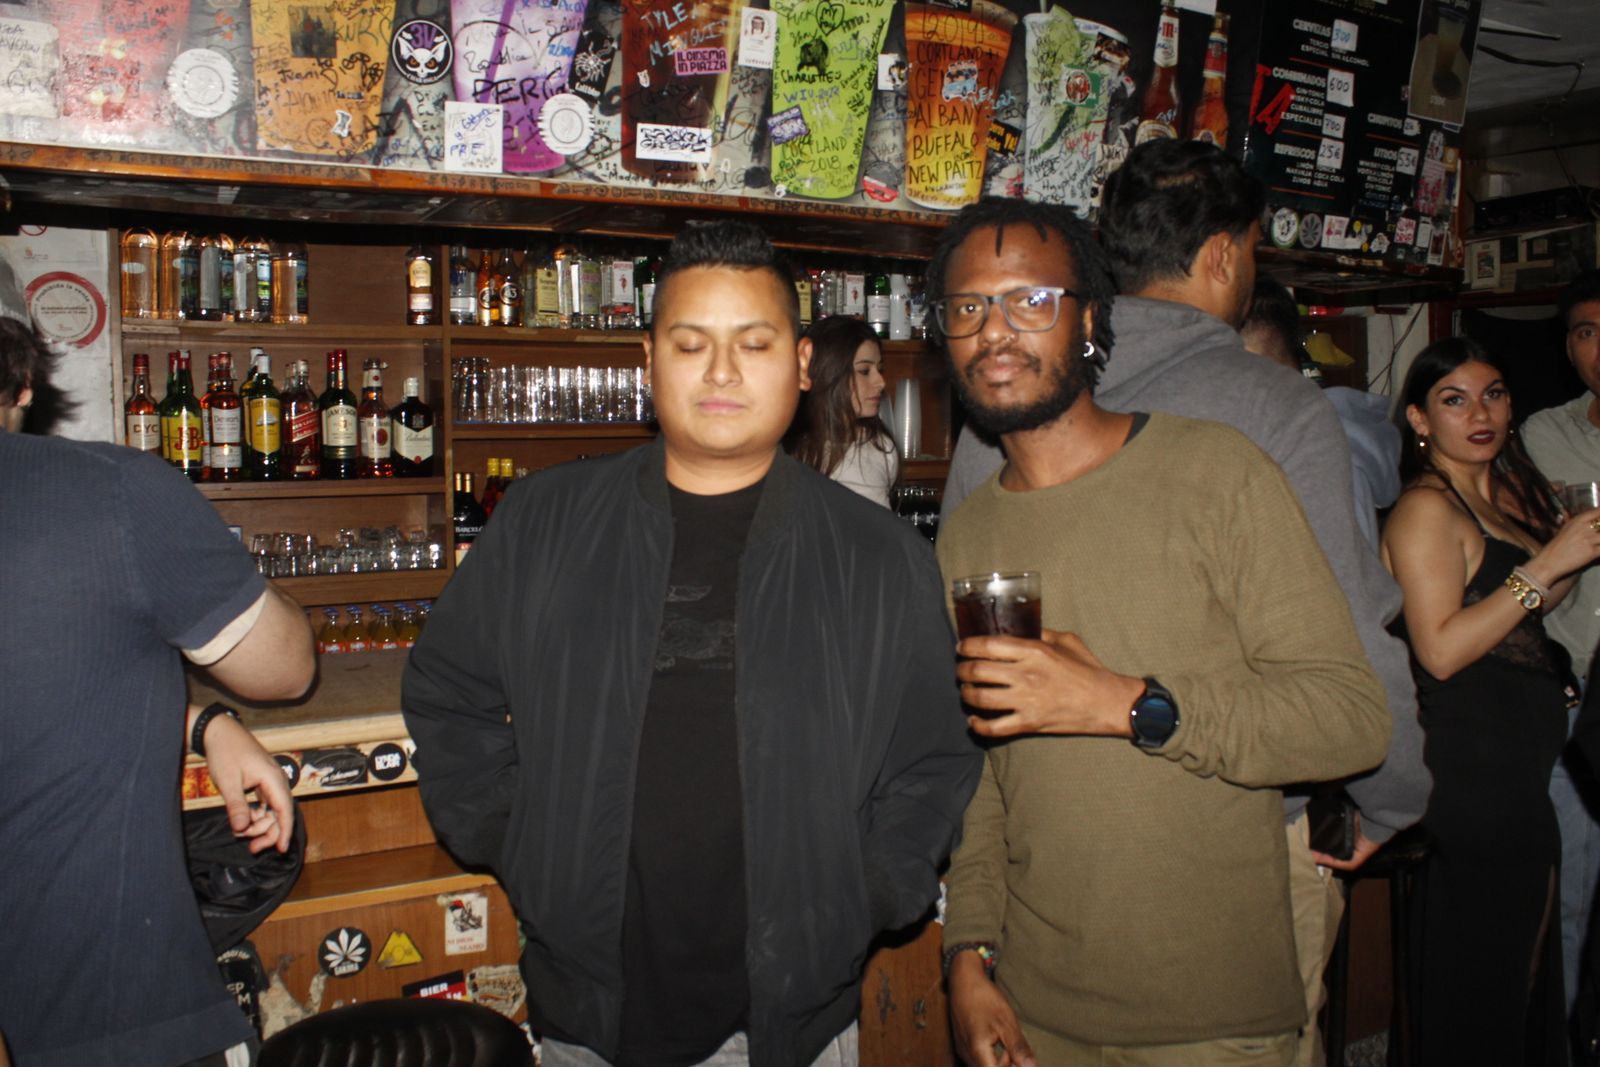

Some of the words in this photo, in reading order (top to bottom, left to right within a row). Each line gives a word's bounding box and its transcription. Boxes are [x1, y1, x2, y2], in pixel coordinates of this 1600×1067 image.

[410, 23, 437, 48] 3V
[686, 49, 727, 61] CINEMA
[689, 60, 728, 72] PIAZZA
[914, 103, 983, 129] ALBANY
[913, 130, 979, 160] BUFFALO
[908, 162, 940, 185] NEW
[419, 982, 449, 998] BIER
